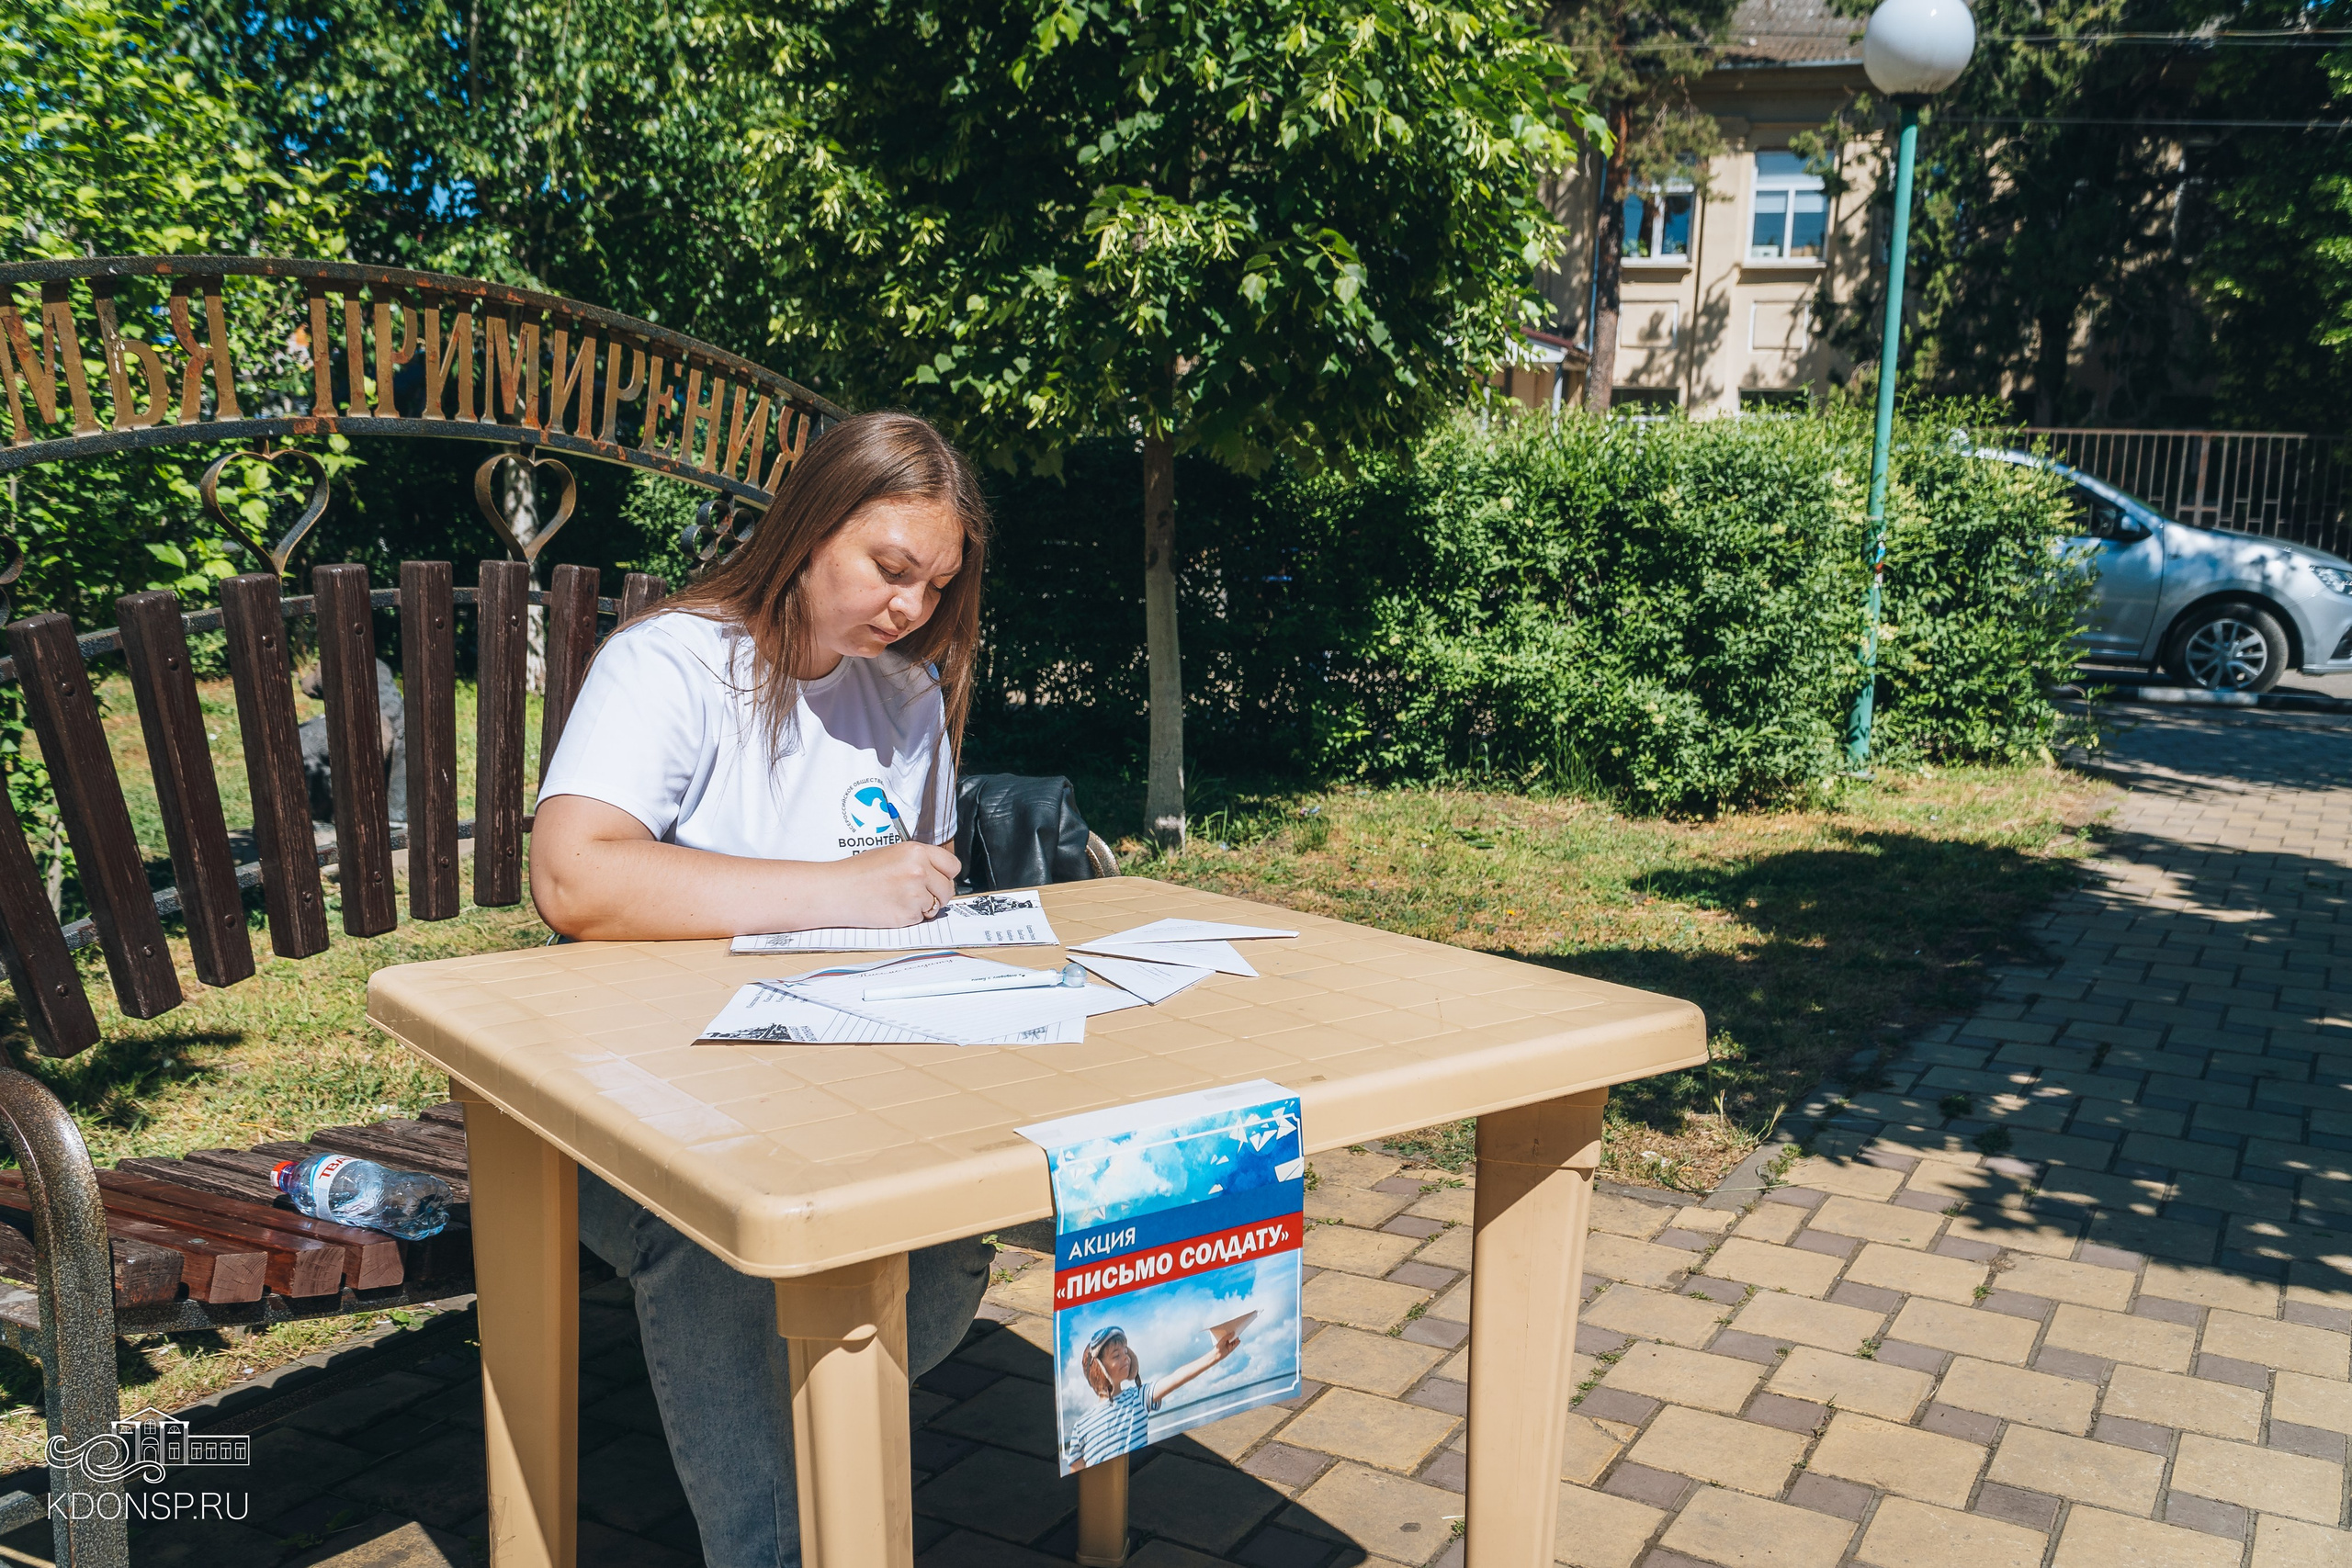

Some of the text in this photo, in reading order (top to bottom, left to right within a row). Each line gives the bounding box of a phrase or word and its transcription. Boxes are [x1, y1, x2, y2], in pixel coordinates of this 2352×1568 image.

[306, 279, 814, 496] ПРИМИРЕНИЯ
[841, 784, 856, 833] ВСЕРОССИЙСКОЕ
[838, 832, 900, 848] ВОЛОНТЁР
[319, 1156, 354, 1179] ТВА
[1057, 1224, 1289, 1300] «ПИСЬМО СОЛДАТУ»
[1068, 1226, 1136, 1260] АКЦИЯ
